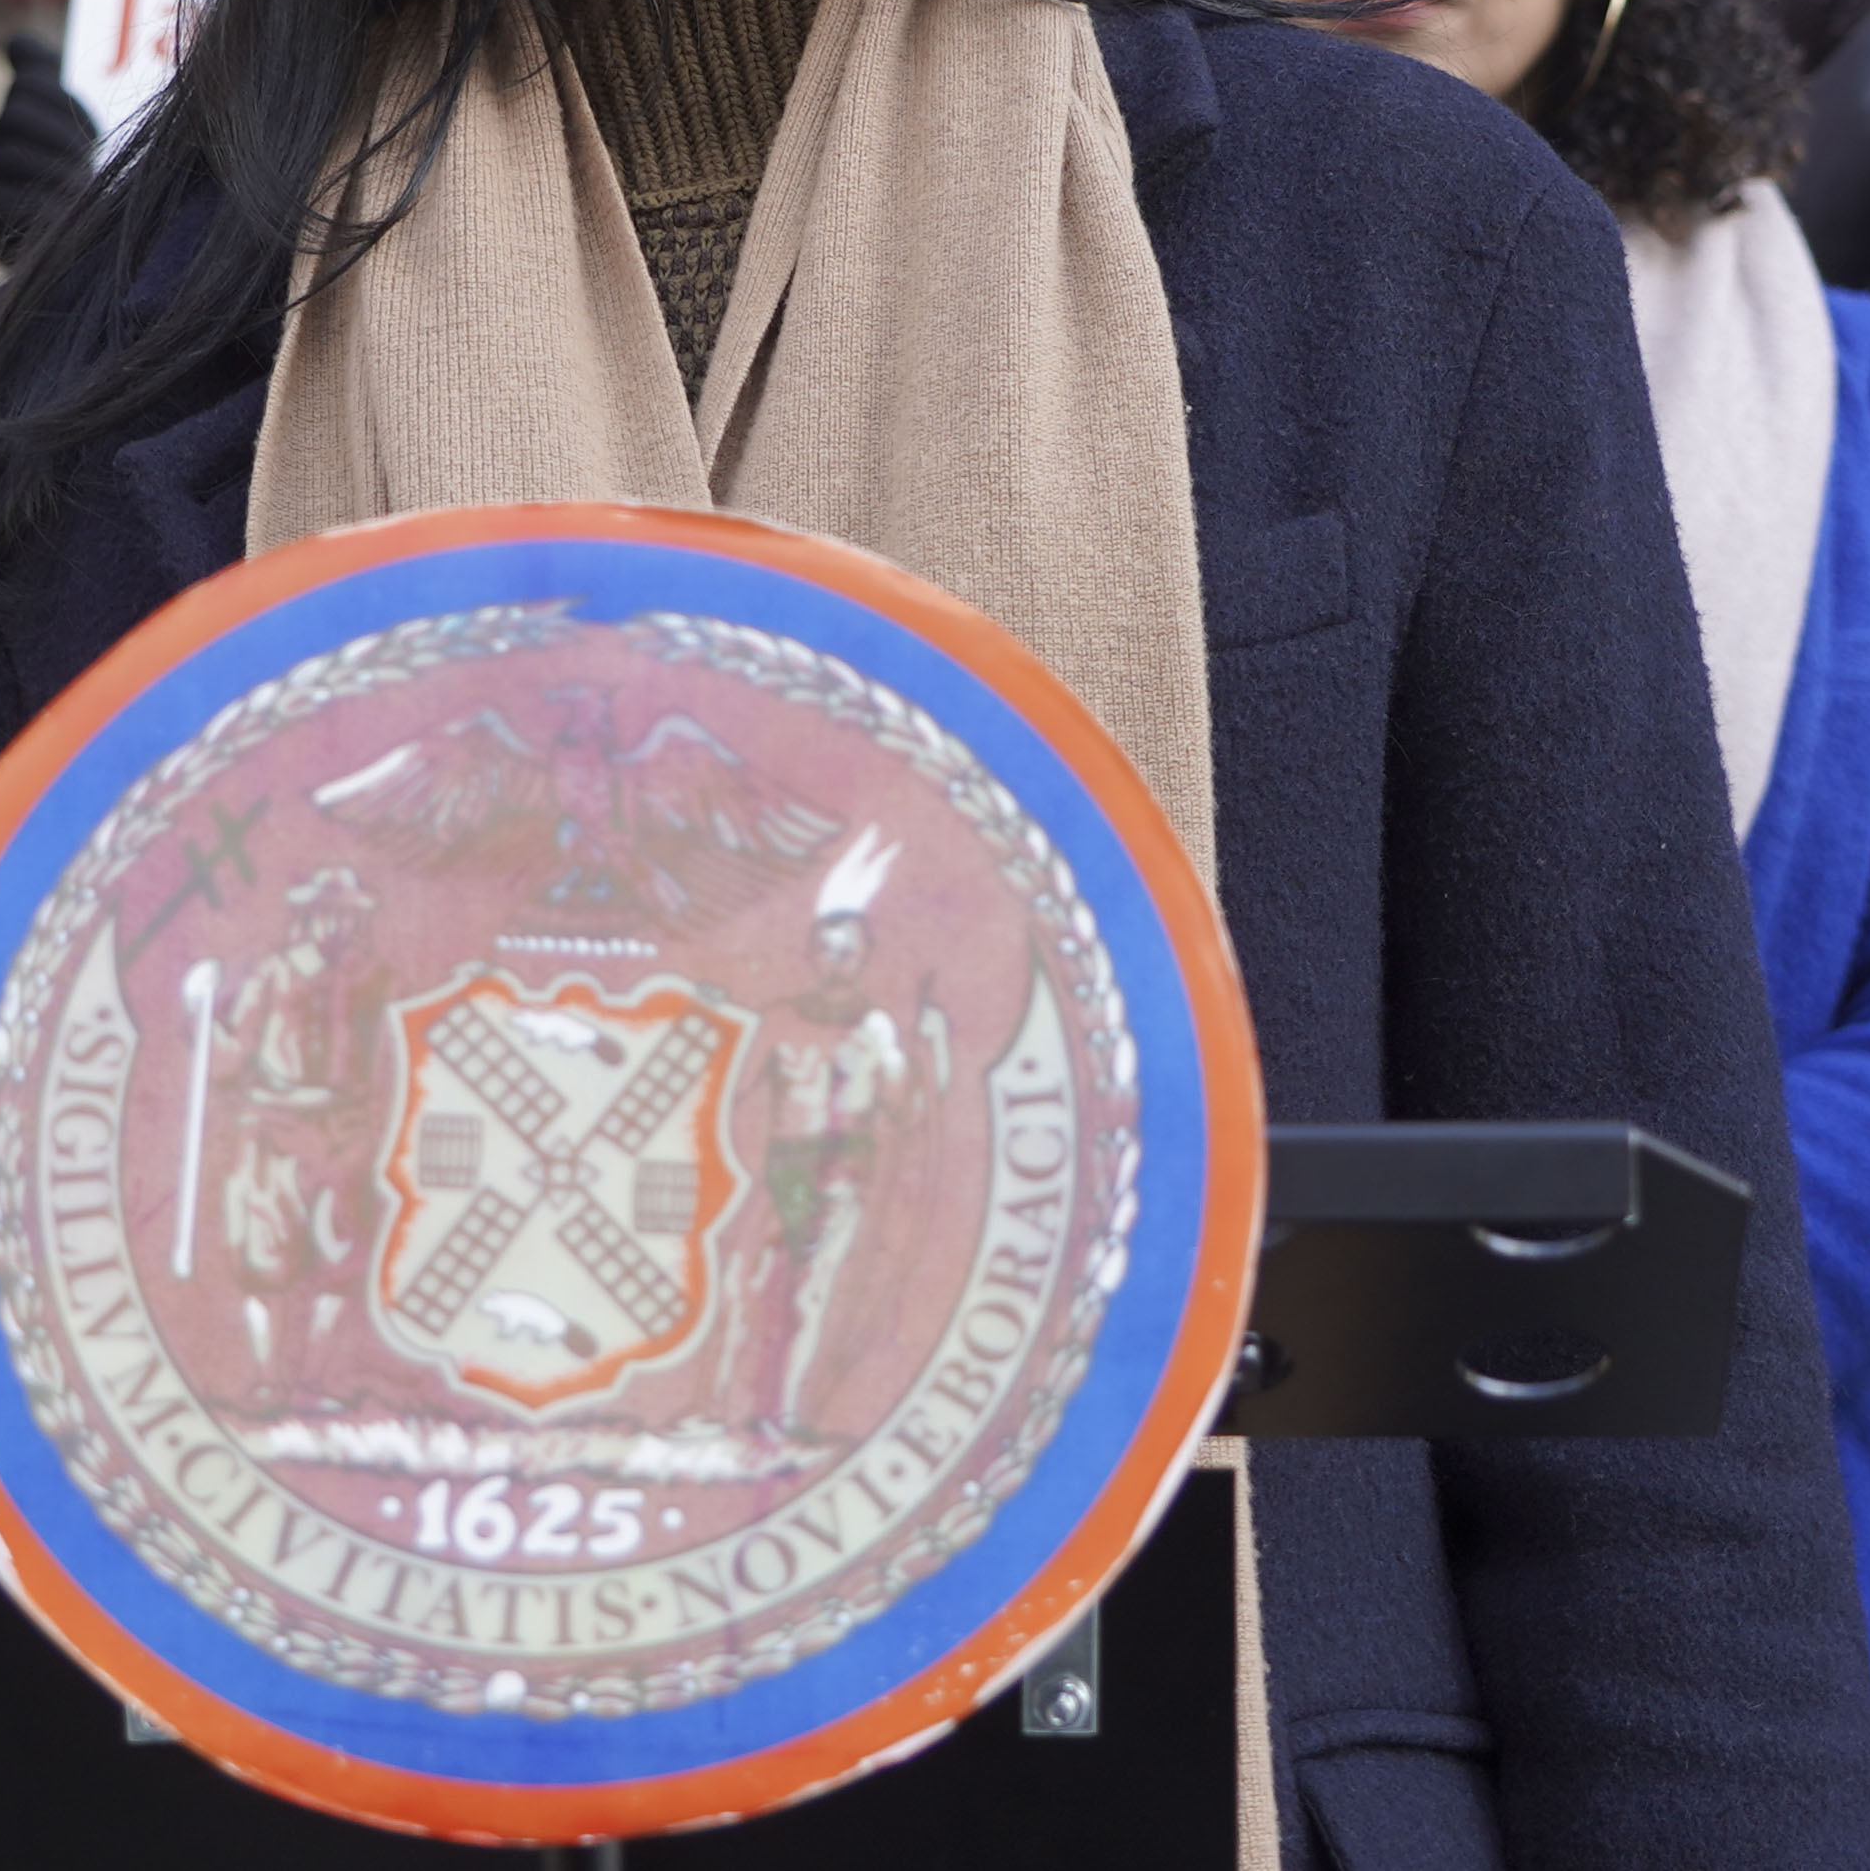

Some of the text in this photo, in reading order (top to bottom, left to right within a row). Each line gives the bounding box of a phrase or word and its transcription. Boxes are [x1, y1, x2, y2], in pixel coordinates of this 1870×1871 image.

[174, 1440, 635, 1646] CIVITATIS
[664, 1468, 913, 1630] NOVI
[888, 1086, 1068, 1483] EBORACI
[414, 1474, 646, 1560] 1625
